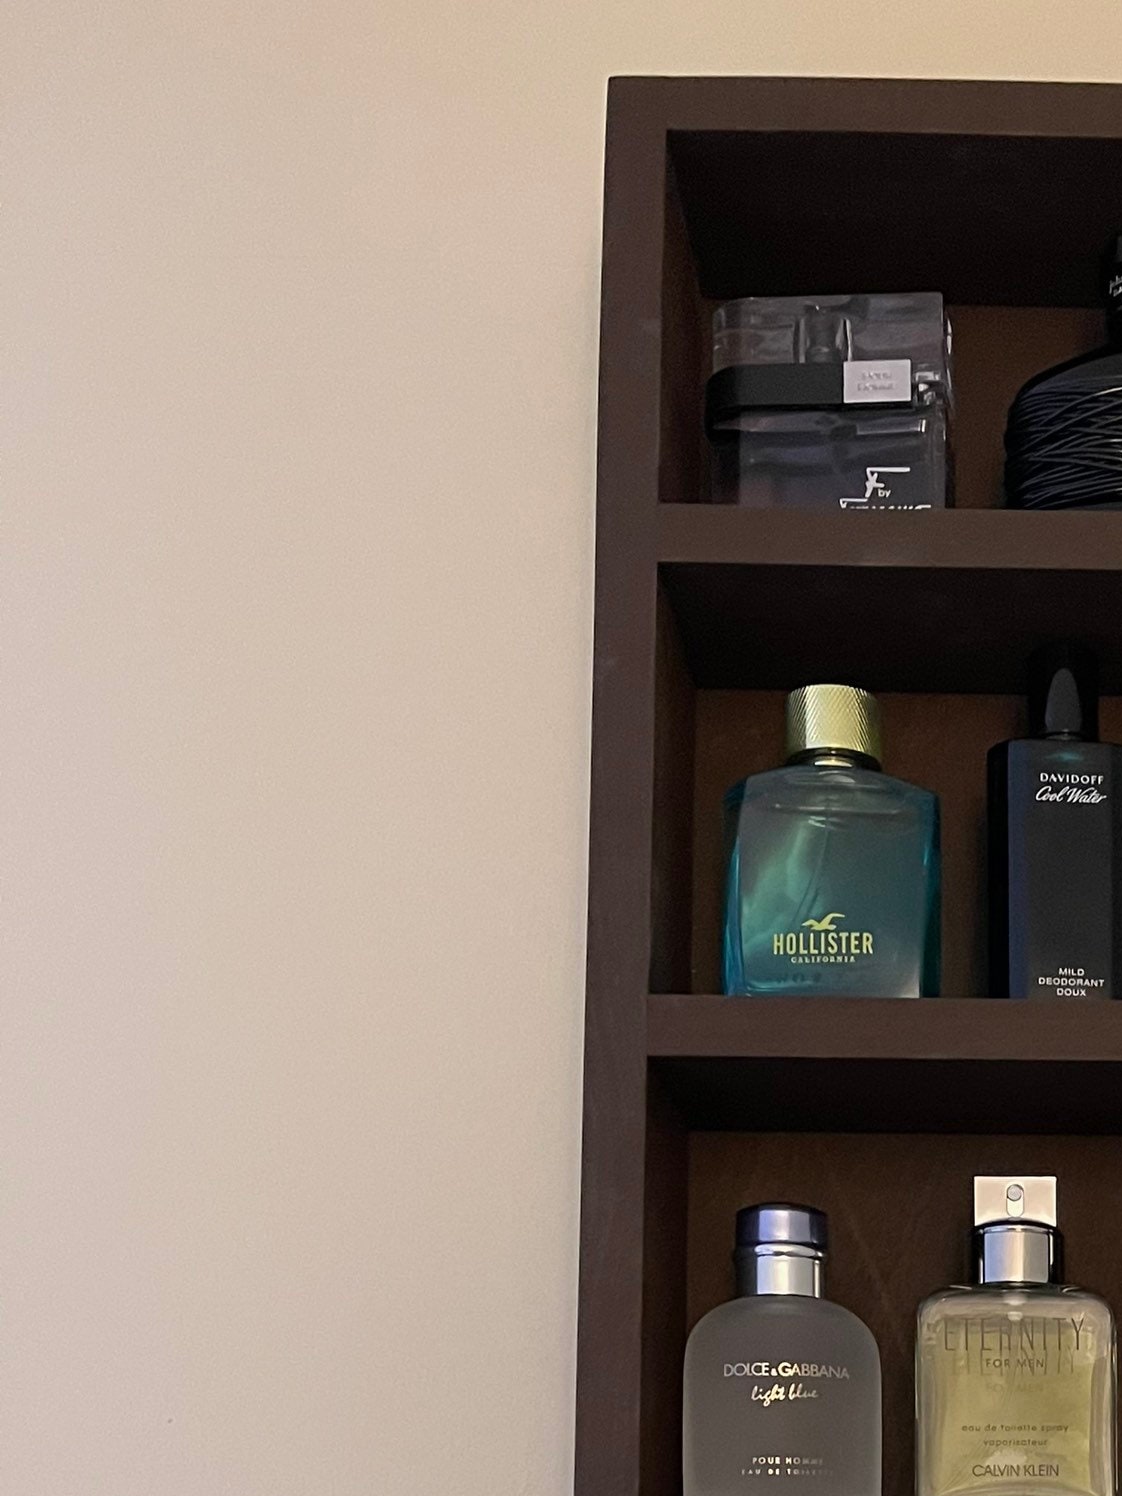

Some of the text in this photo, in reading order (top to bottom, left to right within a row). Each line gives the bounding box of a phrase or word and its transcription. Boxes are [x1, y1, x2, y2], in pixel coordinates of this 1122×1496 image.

[878, 489, 891, 498] by
[1039, 772, 1104, 785] DAVIDOFF
[1035, 785, 1107, 804] Cool Water
[773, 932, 874, 955] HOLLISTER
[790, 955, 856, 964] CALIFORNIA
[1058, 968, 1085, 977] MILD
[1038, 977, 1105, 987] DEODORANT
[1056, 988, 1086, 997] DOUX
[943, 1317, 1085, 1351] ETERNITY
[985, 1358, 1045, 1368] FOR MEN
[751, 1383, 819, 1407] light blue
[984, 1424, 997, 1432] de
[1000, 1424, 1037, 1432] toilette
[1040, 1425, 1069, 1435] spray
[983, 1438, 1048, 1447] vaporisateur
[752, 1457, 781, 1465] POUR
[767, 1468, 780, 1476] DE
[971, 1464, 1060, 1477] CALVIN KLEIN
